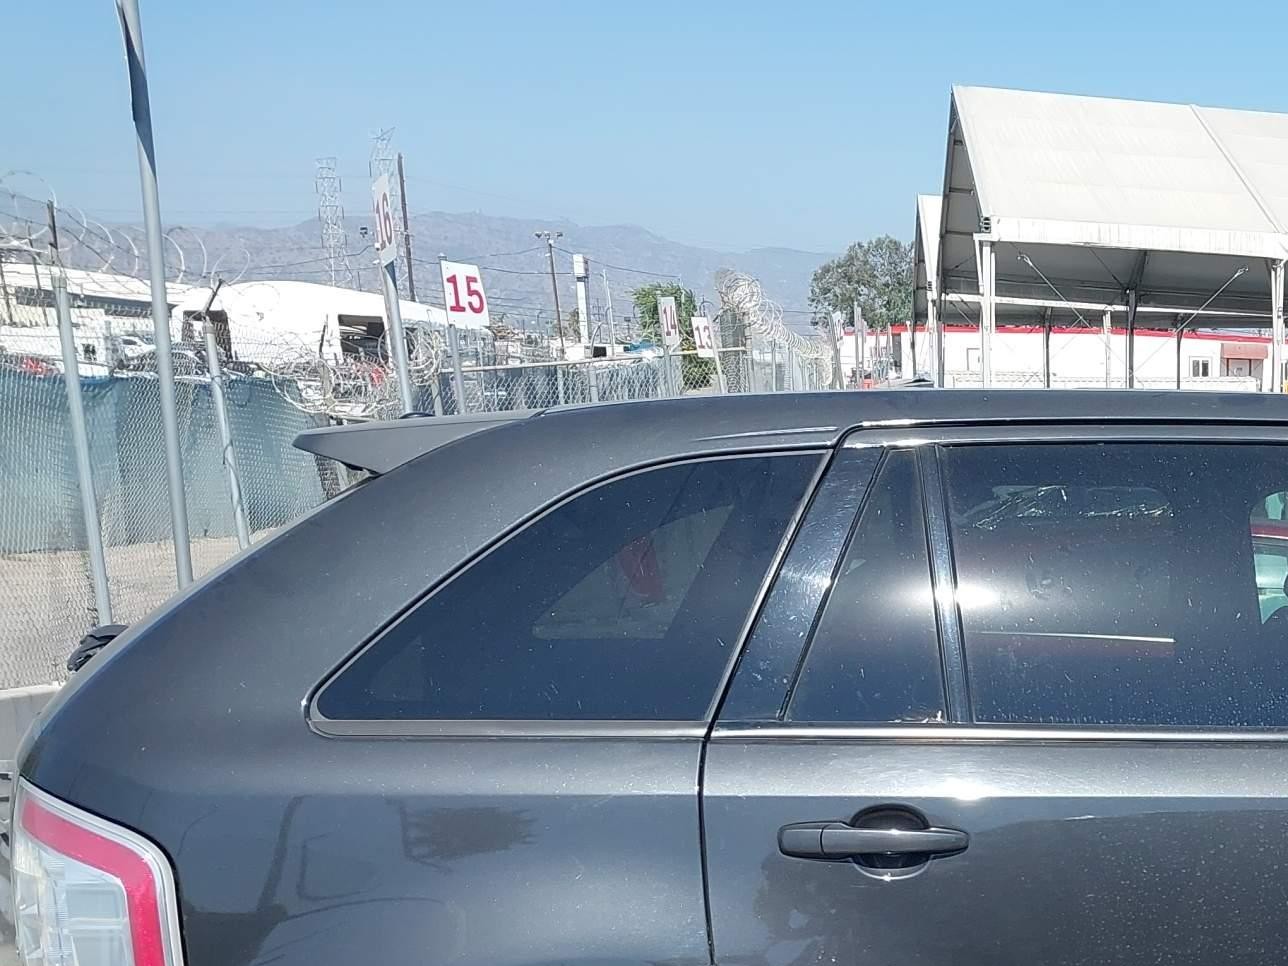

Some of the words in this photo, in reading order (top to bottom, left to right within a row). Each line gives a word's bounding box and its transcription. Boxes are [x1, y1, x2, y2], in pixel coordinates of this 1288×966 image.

[375, 191, 393, 251] 16
[446, 274, 485, 314] 15
[663, 305, 678, 337] 14
[694, 325, 713, 350] 13
